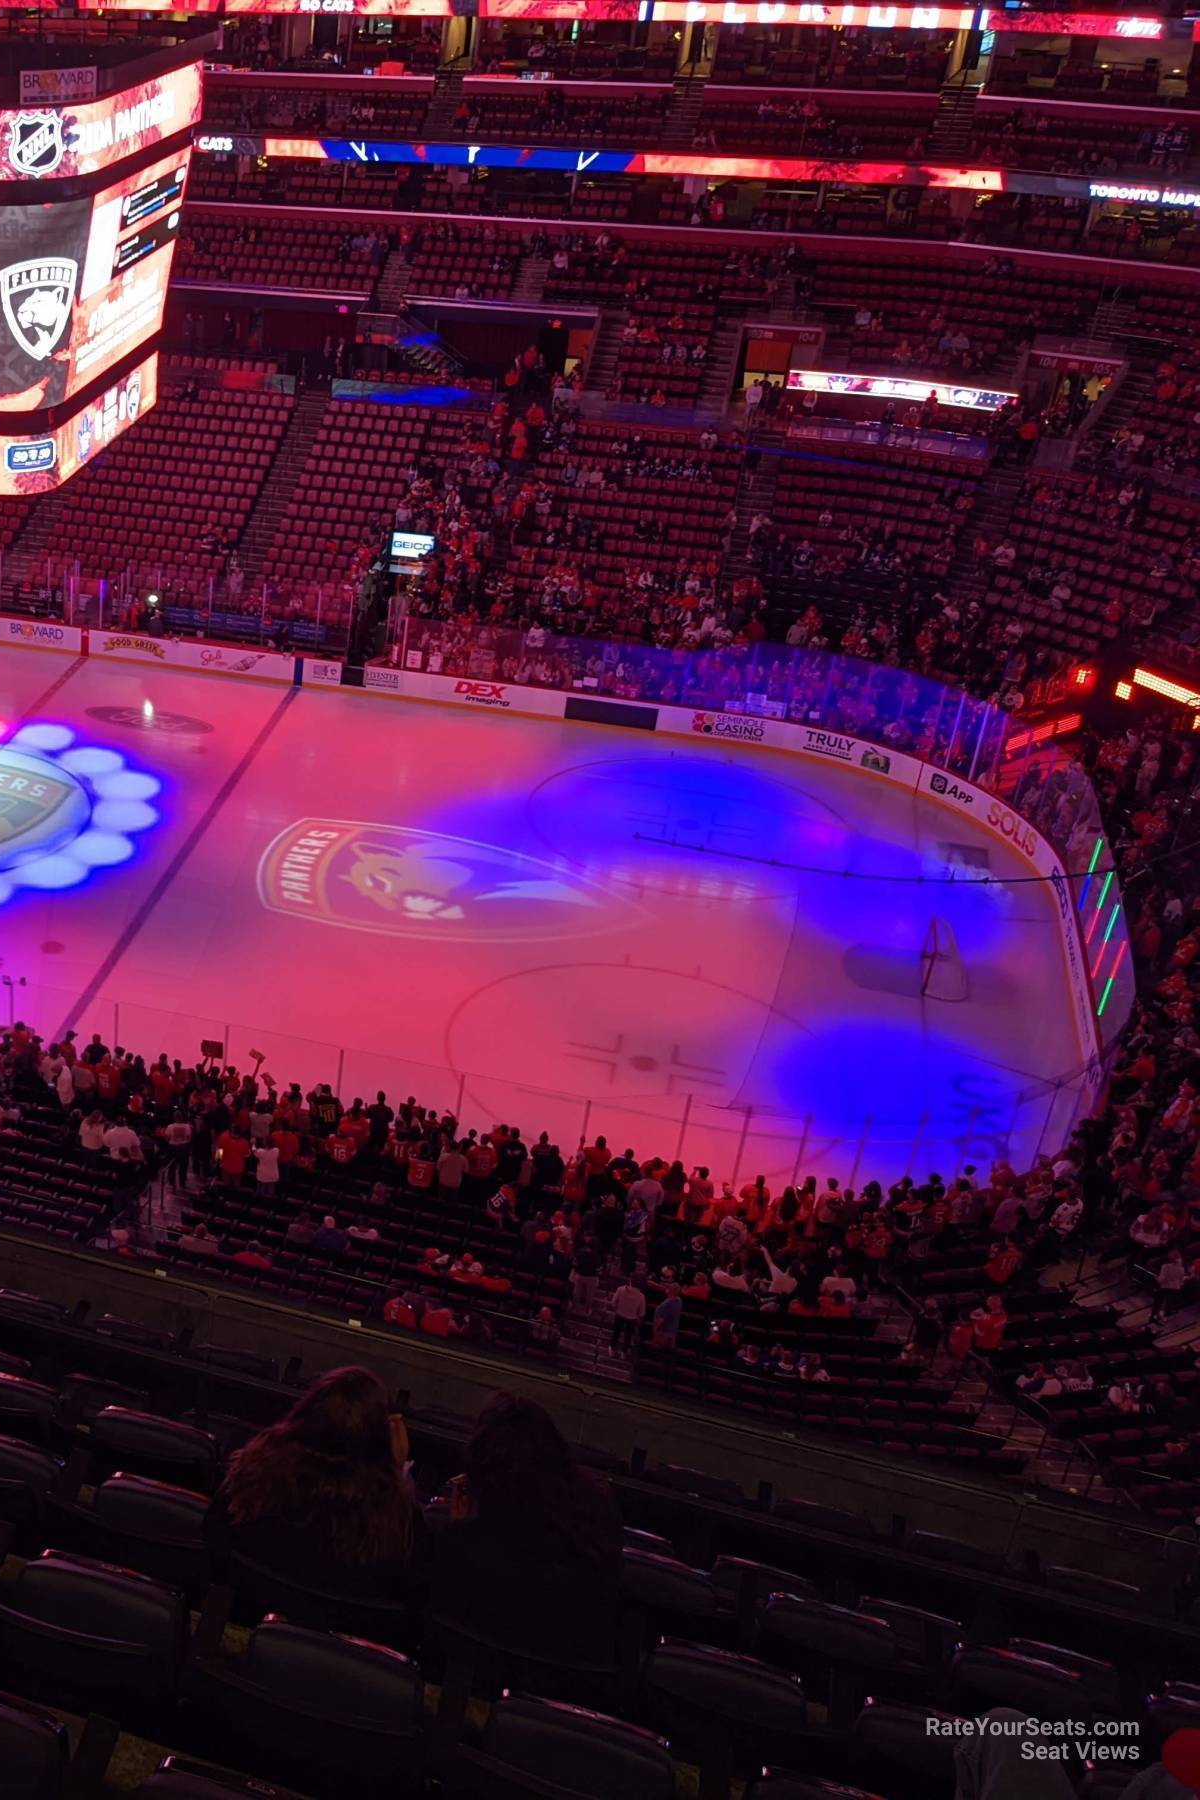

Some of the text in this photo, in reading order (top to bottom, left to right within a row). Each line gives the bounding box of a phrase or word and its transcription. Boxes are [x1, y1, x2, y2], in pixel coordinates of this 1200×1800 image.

[21, 125, 54, 162] NHL
[199, 137, 232, 150] CATS
[1089, 184, 1160, 202] TORONTO
[393, 540, 433, 551] GEICO
[453, 681, 507, 699] DEX
[465, 695, 510, 707] imaging
[717, 714, 766, 729] SEMINOLE
[715, 723, 764, 737] CASINO
[806, 730, 856, 752] TRULY
[987, 802, 1037, 857] SOLIS
[280, 828, 341, 904] PANTHERS
[415, 1168, 425, 1179] 3
